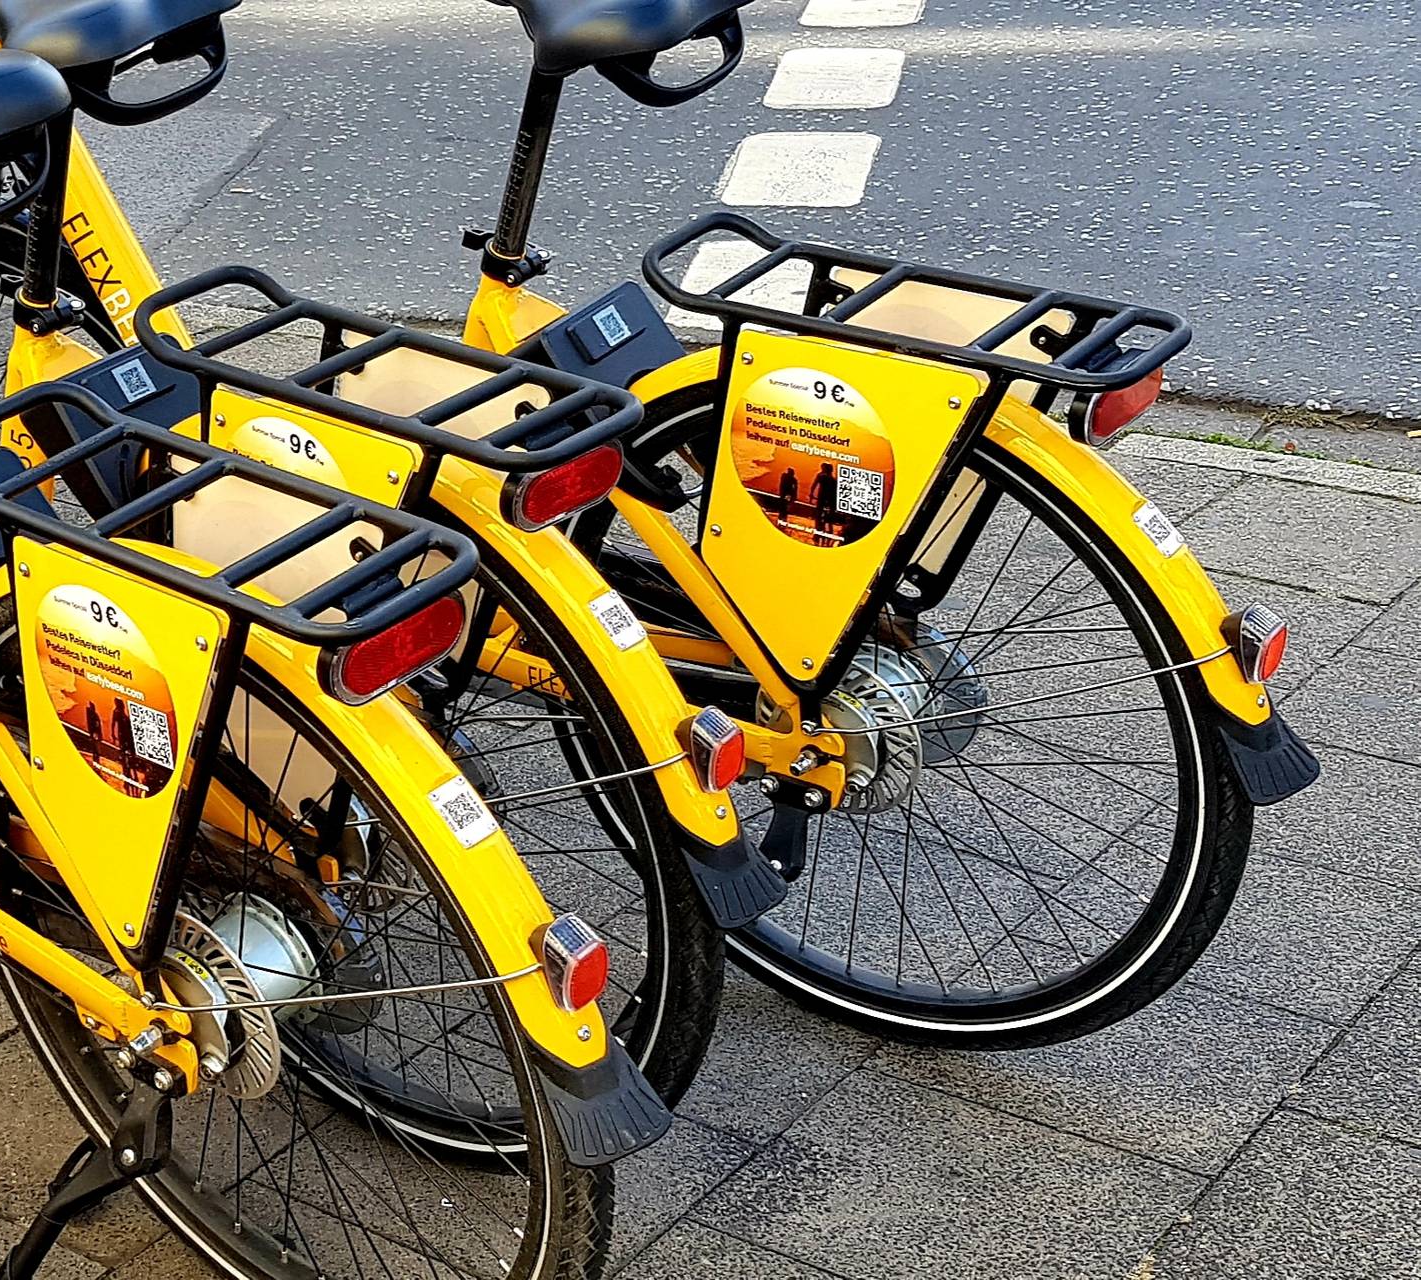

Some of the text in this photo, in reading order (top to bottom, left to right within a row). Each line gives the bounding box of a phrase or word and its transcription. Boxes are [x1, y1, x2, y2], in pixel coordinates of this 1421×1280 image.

[62, 212, 140, 347] FLEXBE
[813, 381, 827, 400] 9
[830, 384, 845, 404] €
[746, 403, 841, 431] Bestes Reisewetter?
[746, 417, 851, 447] Pedelecs in Düsseldorf
[775, 438, 790, 448] auf
[289, 433, 301, 454] 9
[304, 439, 317, 460] €
[90, 600, 103, 623] 9
[105, 606, 119, 628] €
